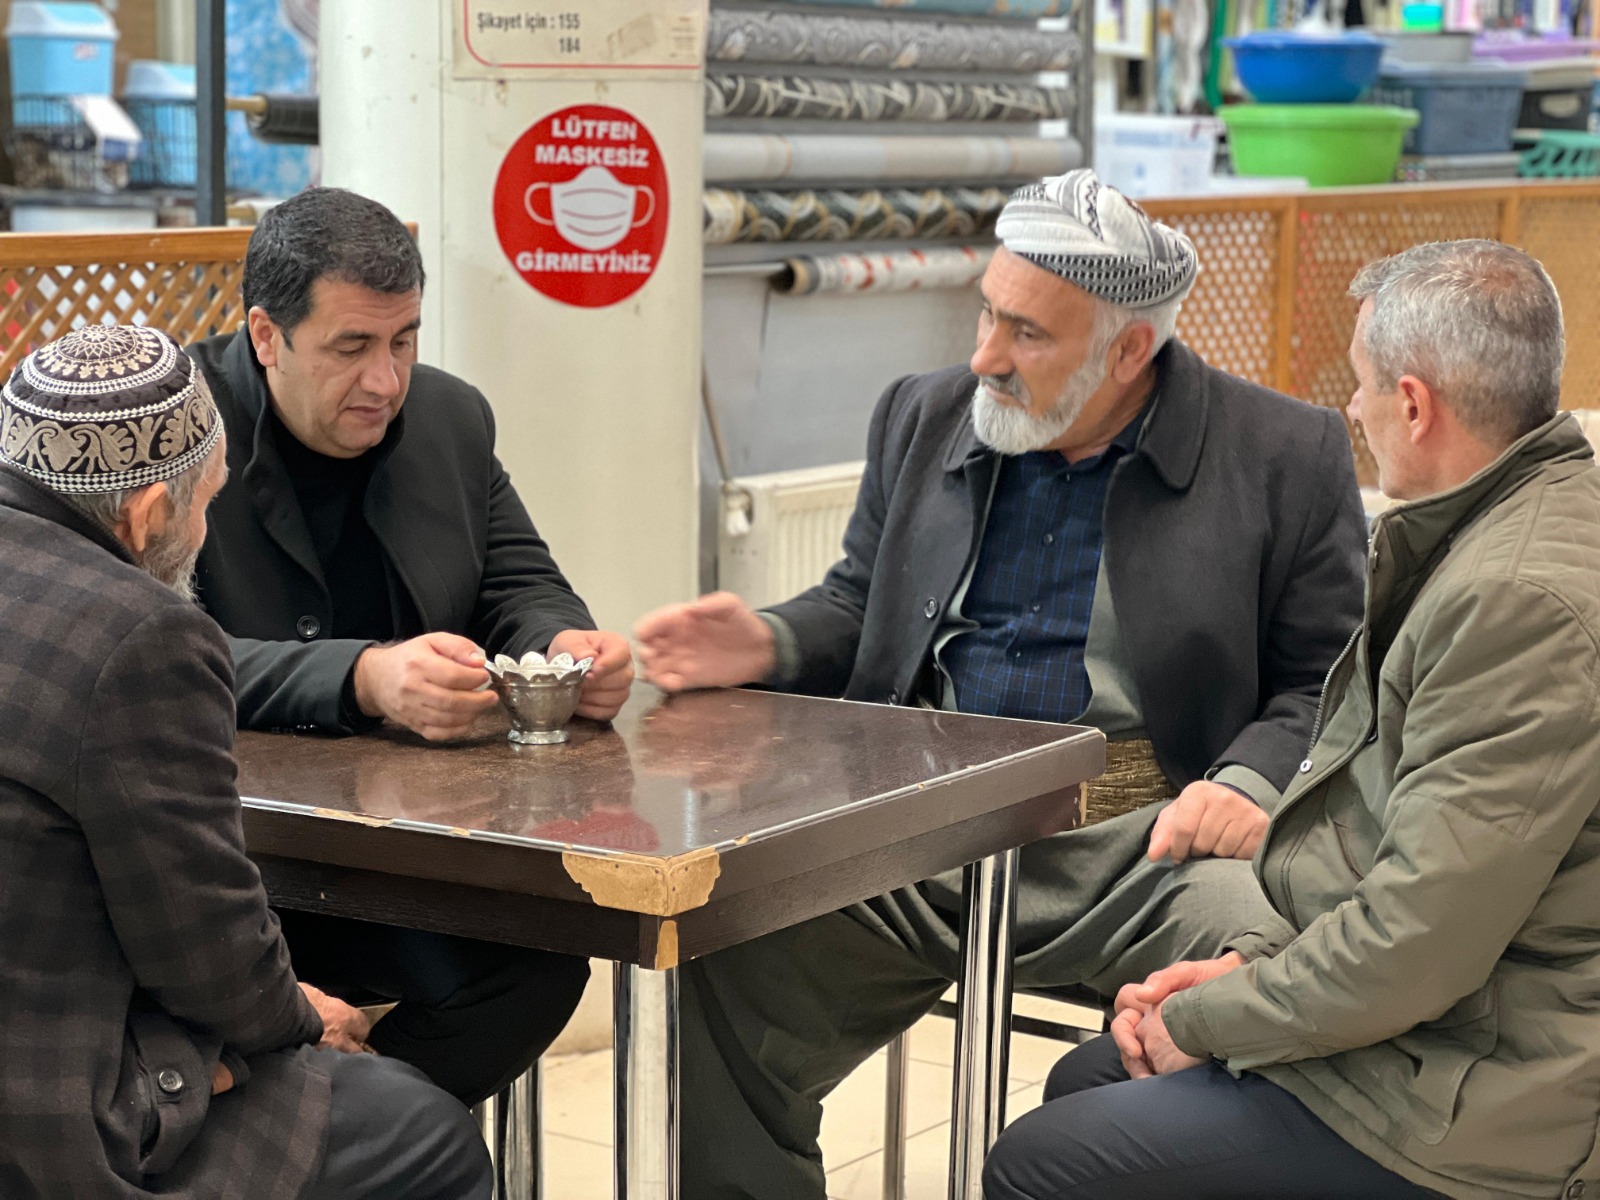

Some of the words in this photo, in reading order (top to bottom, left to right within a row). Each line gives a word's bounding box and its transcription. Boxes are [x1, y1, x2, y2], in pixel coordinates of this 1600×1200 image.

[477, 12, 522, 33] Şikayet
[525, 12, 547, 33] için
[559, 13, 580, 29] 155
[559, 37, 580, 53] 184
[551, 114, 637, 140] LÜTFEN
[535, 144, 649, 167] MASKESİZ
[516, 247, 651, 273] GİRMEYİNİZ
